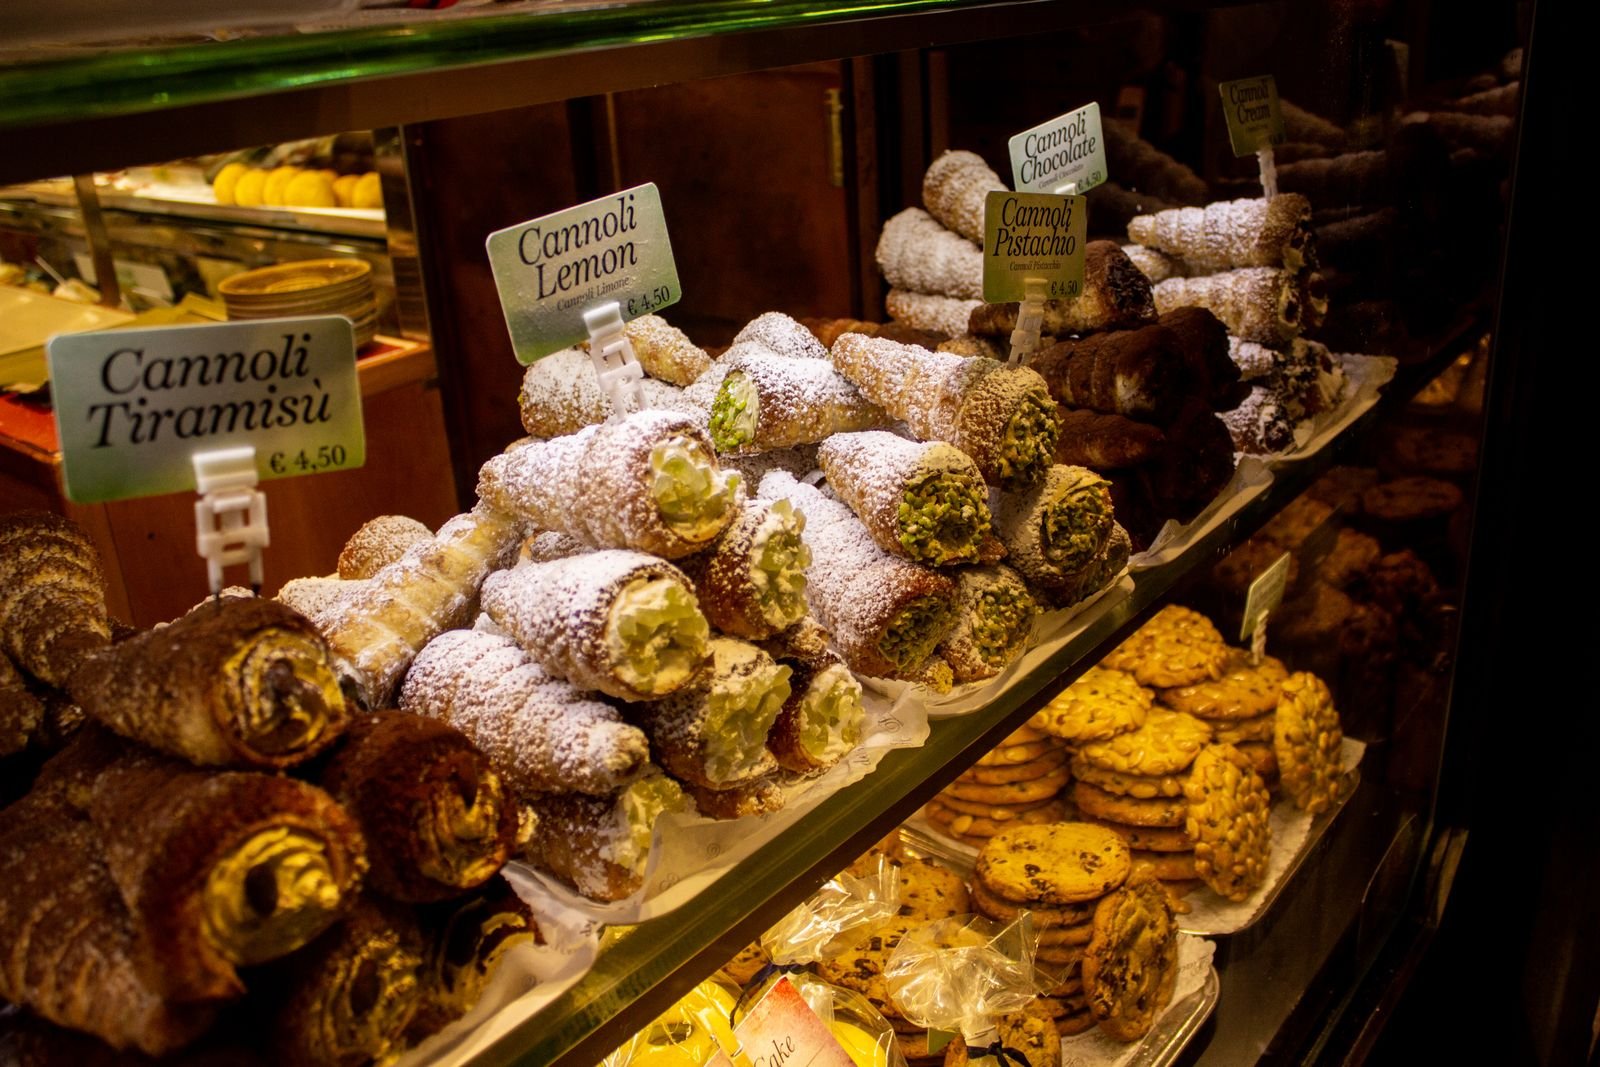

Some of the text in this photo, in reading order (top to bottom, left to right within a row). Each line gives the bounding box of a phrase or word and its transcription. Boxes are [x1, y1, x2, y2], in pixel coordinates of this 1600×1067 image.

[1025, 111, 1086, 158] Cannoli
[1021, 136, 1096, 184] Chocolate
[518, 194, 637, 265] Cannoli
[1002, 197, 1074, 228] Cannoli
[992, 226, 1076, 257] Pistachio
[535, 242, 637, 300] Lemon
[1051, 279, 1079, 296] € 4,50
[556, 276, 630, 312] Cannoli Limone
[626, 285, 671, 316] € 4,50
[102, 333, 311, 394] Cannoli
[86, 378, 332, 449] Tiramisù
[269, 444, 347, 474] € 4,50
